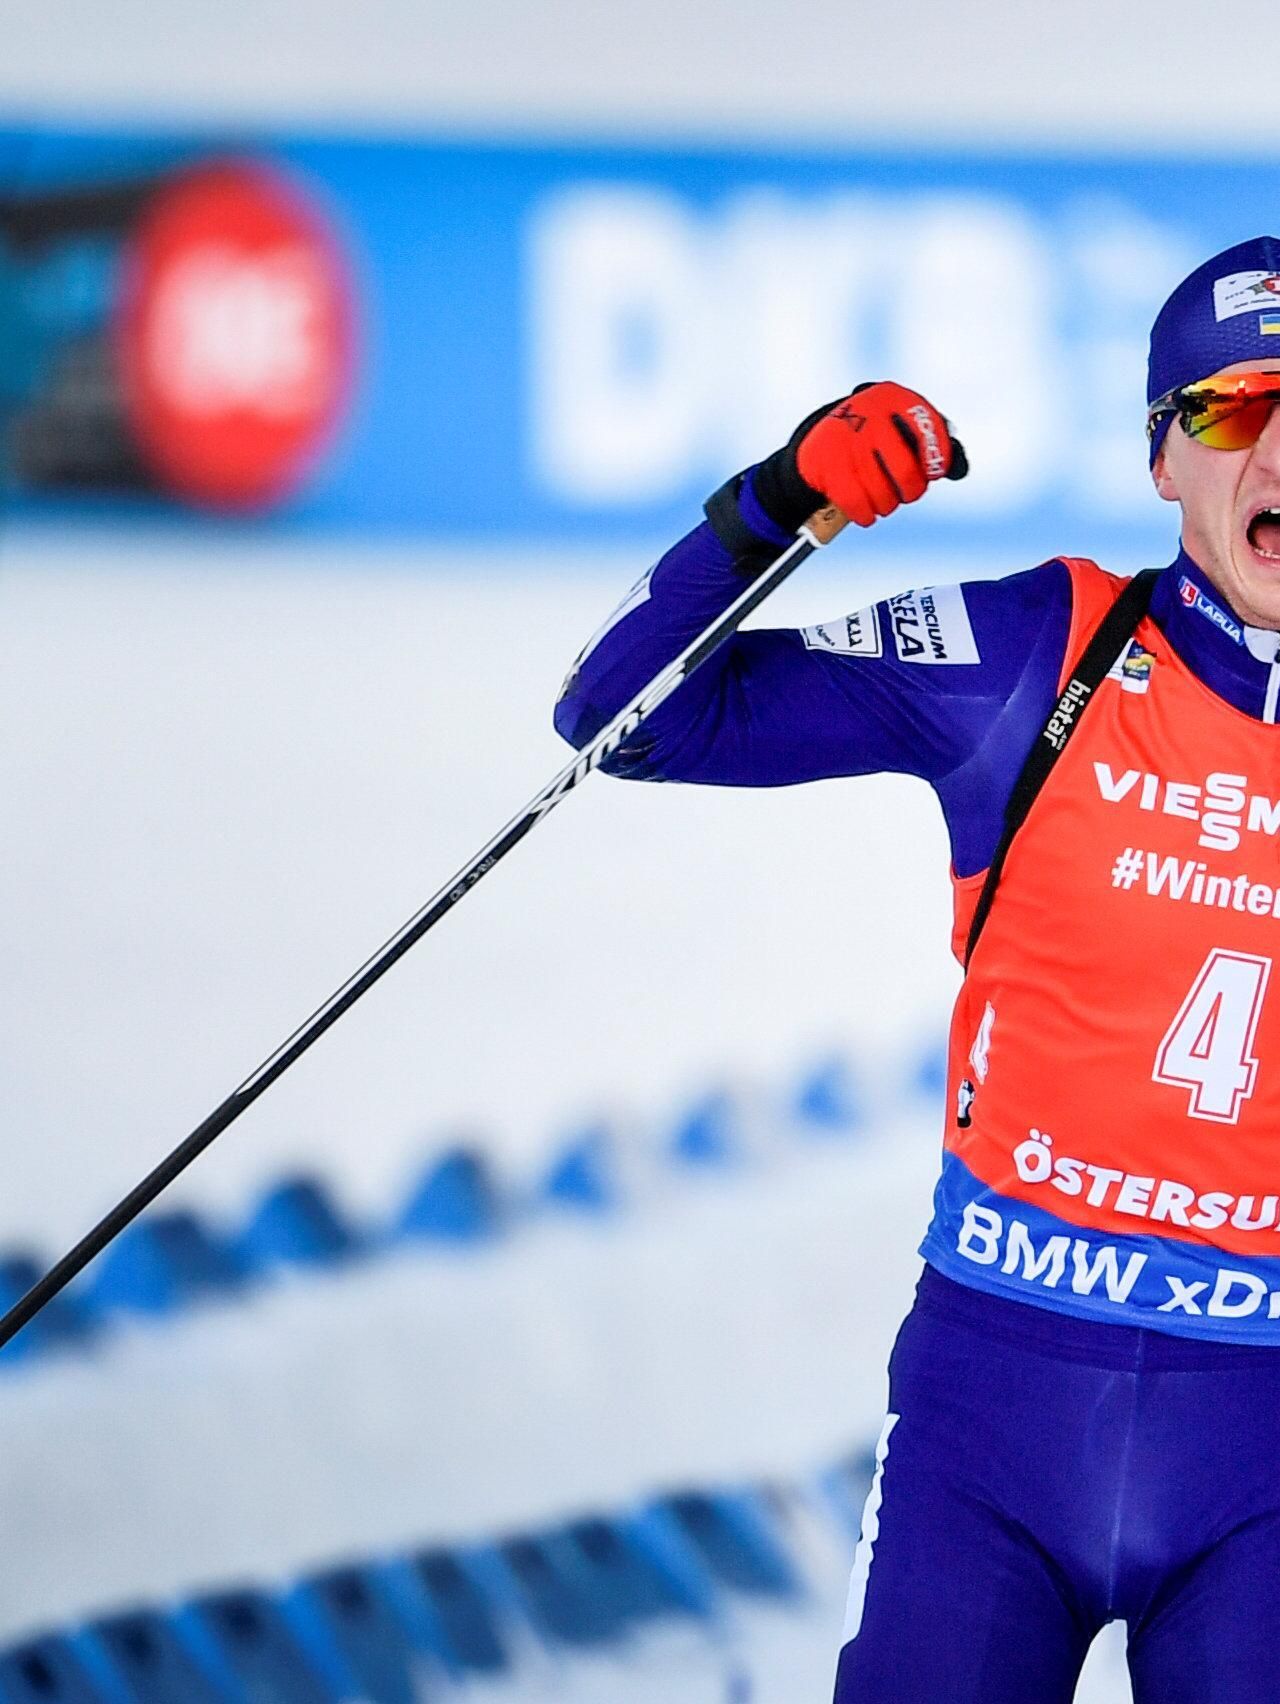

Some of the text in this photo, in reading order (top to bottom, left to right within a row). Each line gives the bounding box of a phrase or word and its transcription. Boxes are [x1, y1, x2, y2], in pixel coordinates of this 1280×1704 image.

[1196, 595, 1243, 645] LAPUA
[1152, 948, 1273, 1125] 4
[957, 1200, 1149, 1304] BMW
